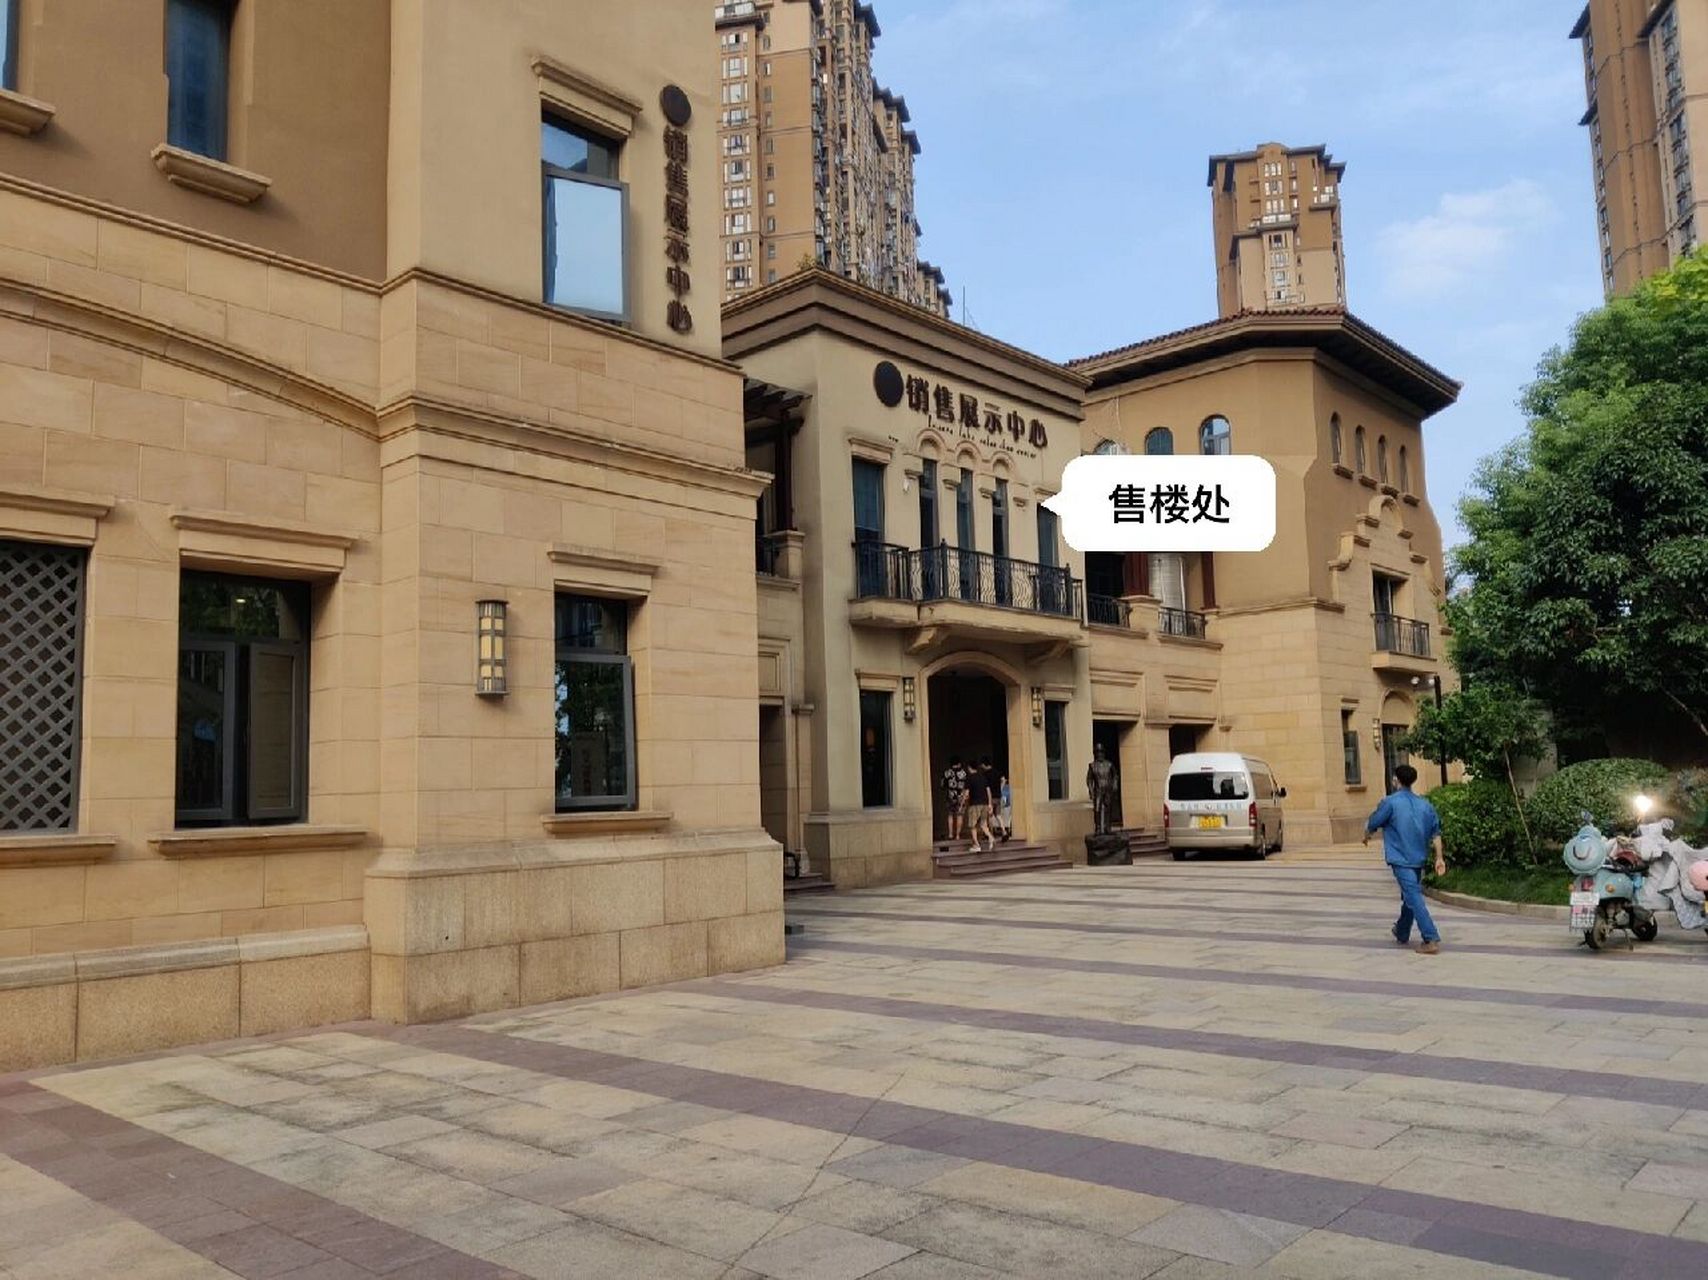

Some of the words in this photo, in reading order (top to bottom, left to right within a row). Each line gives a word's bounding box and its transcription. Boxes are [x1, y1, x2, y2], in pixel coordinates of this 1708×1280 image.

[906, 374, 1048, 449] 销售展示中心
